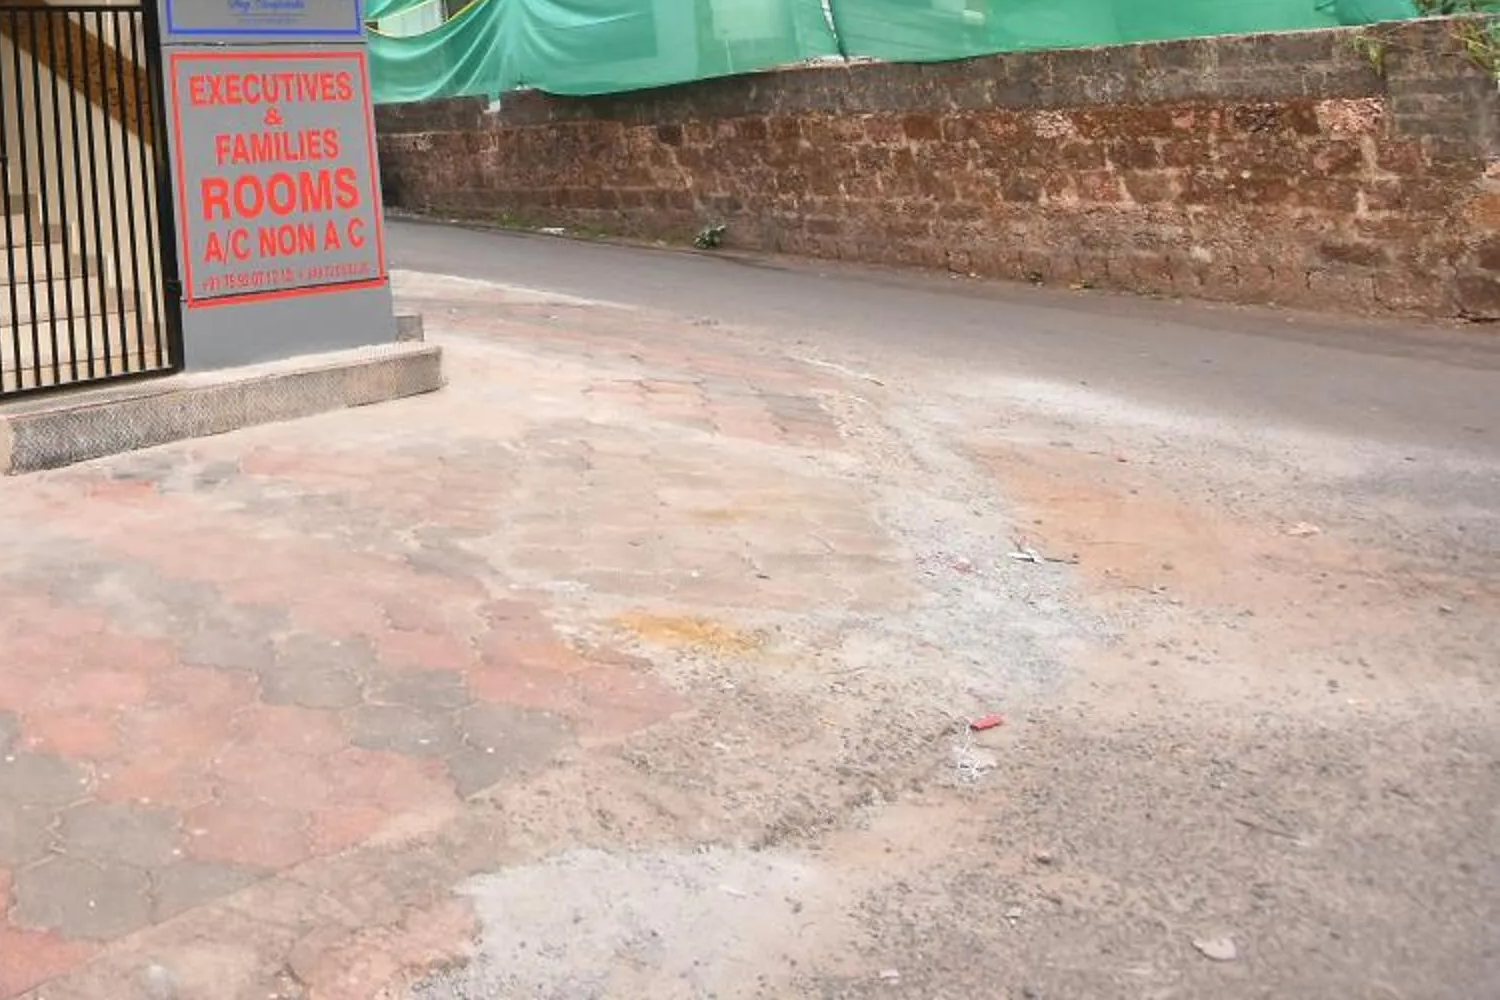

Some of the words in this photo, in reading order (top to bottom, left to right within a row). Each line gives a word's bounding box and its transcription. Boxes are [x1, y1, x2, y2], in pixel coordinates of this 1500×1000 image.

[188, 71, 353, 106] EXECUTIVES
[264, 107, 283, 125] &
[215, 128, 339, 167] FAMILIES
[201, 167, 360, 221] ROOMS
[204, 227, 251, 265] A/C
[259, 223, 316, 258] NON
